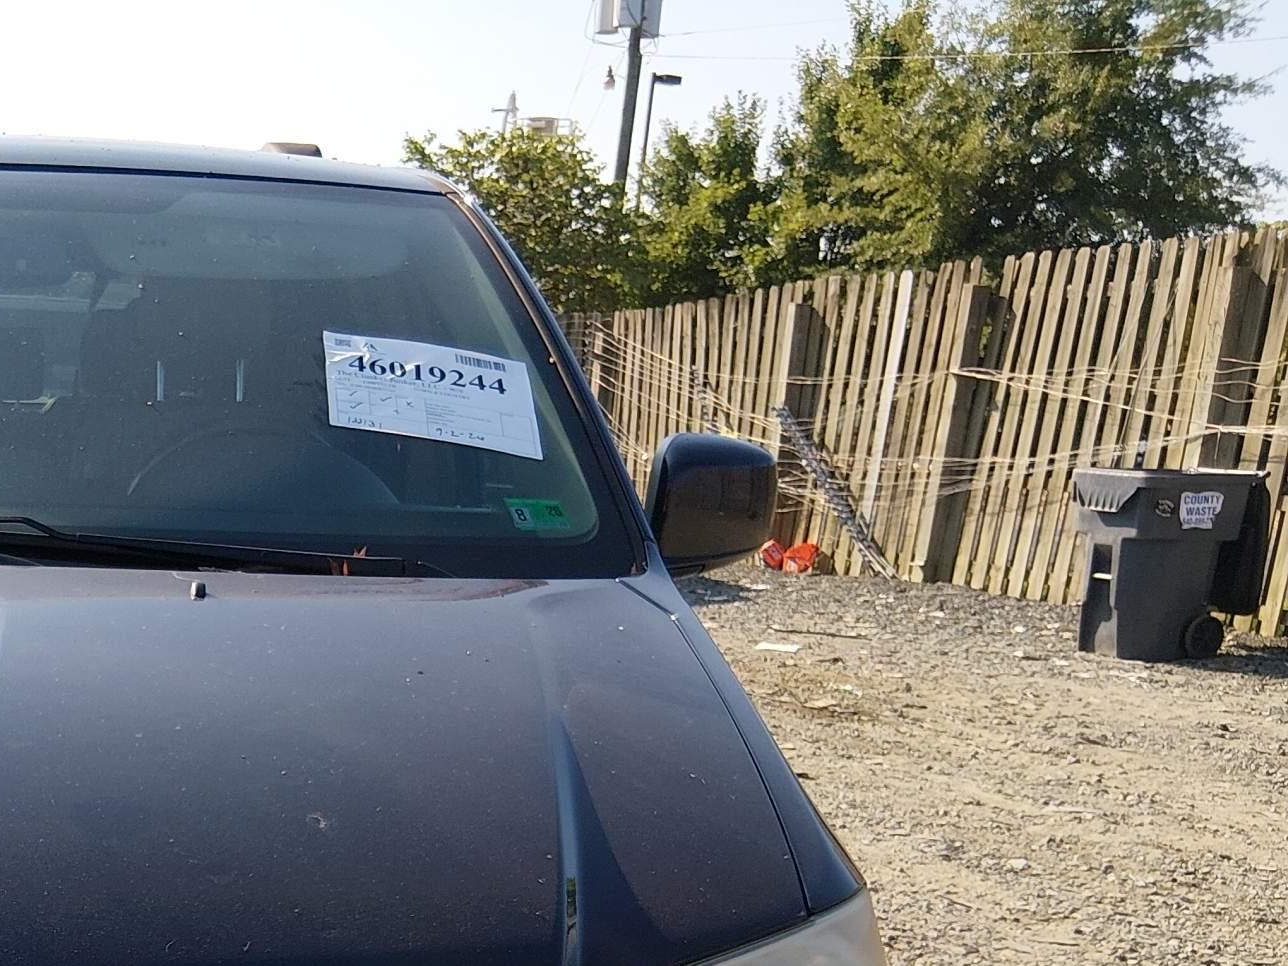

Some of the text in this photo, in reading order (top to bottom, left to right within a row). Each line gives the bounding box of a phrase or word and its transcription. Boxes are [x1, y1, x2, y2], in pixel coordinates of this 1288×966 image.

[348, 356, 507, 394] 46019244
[1184, 495, 1220, 505] COUNTY
[515, 508, 527, 521] 8
[1186, 507, 1217, 516] WASTE
